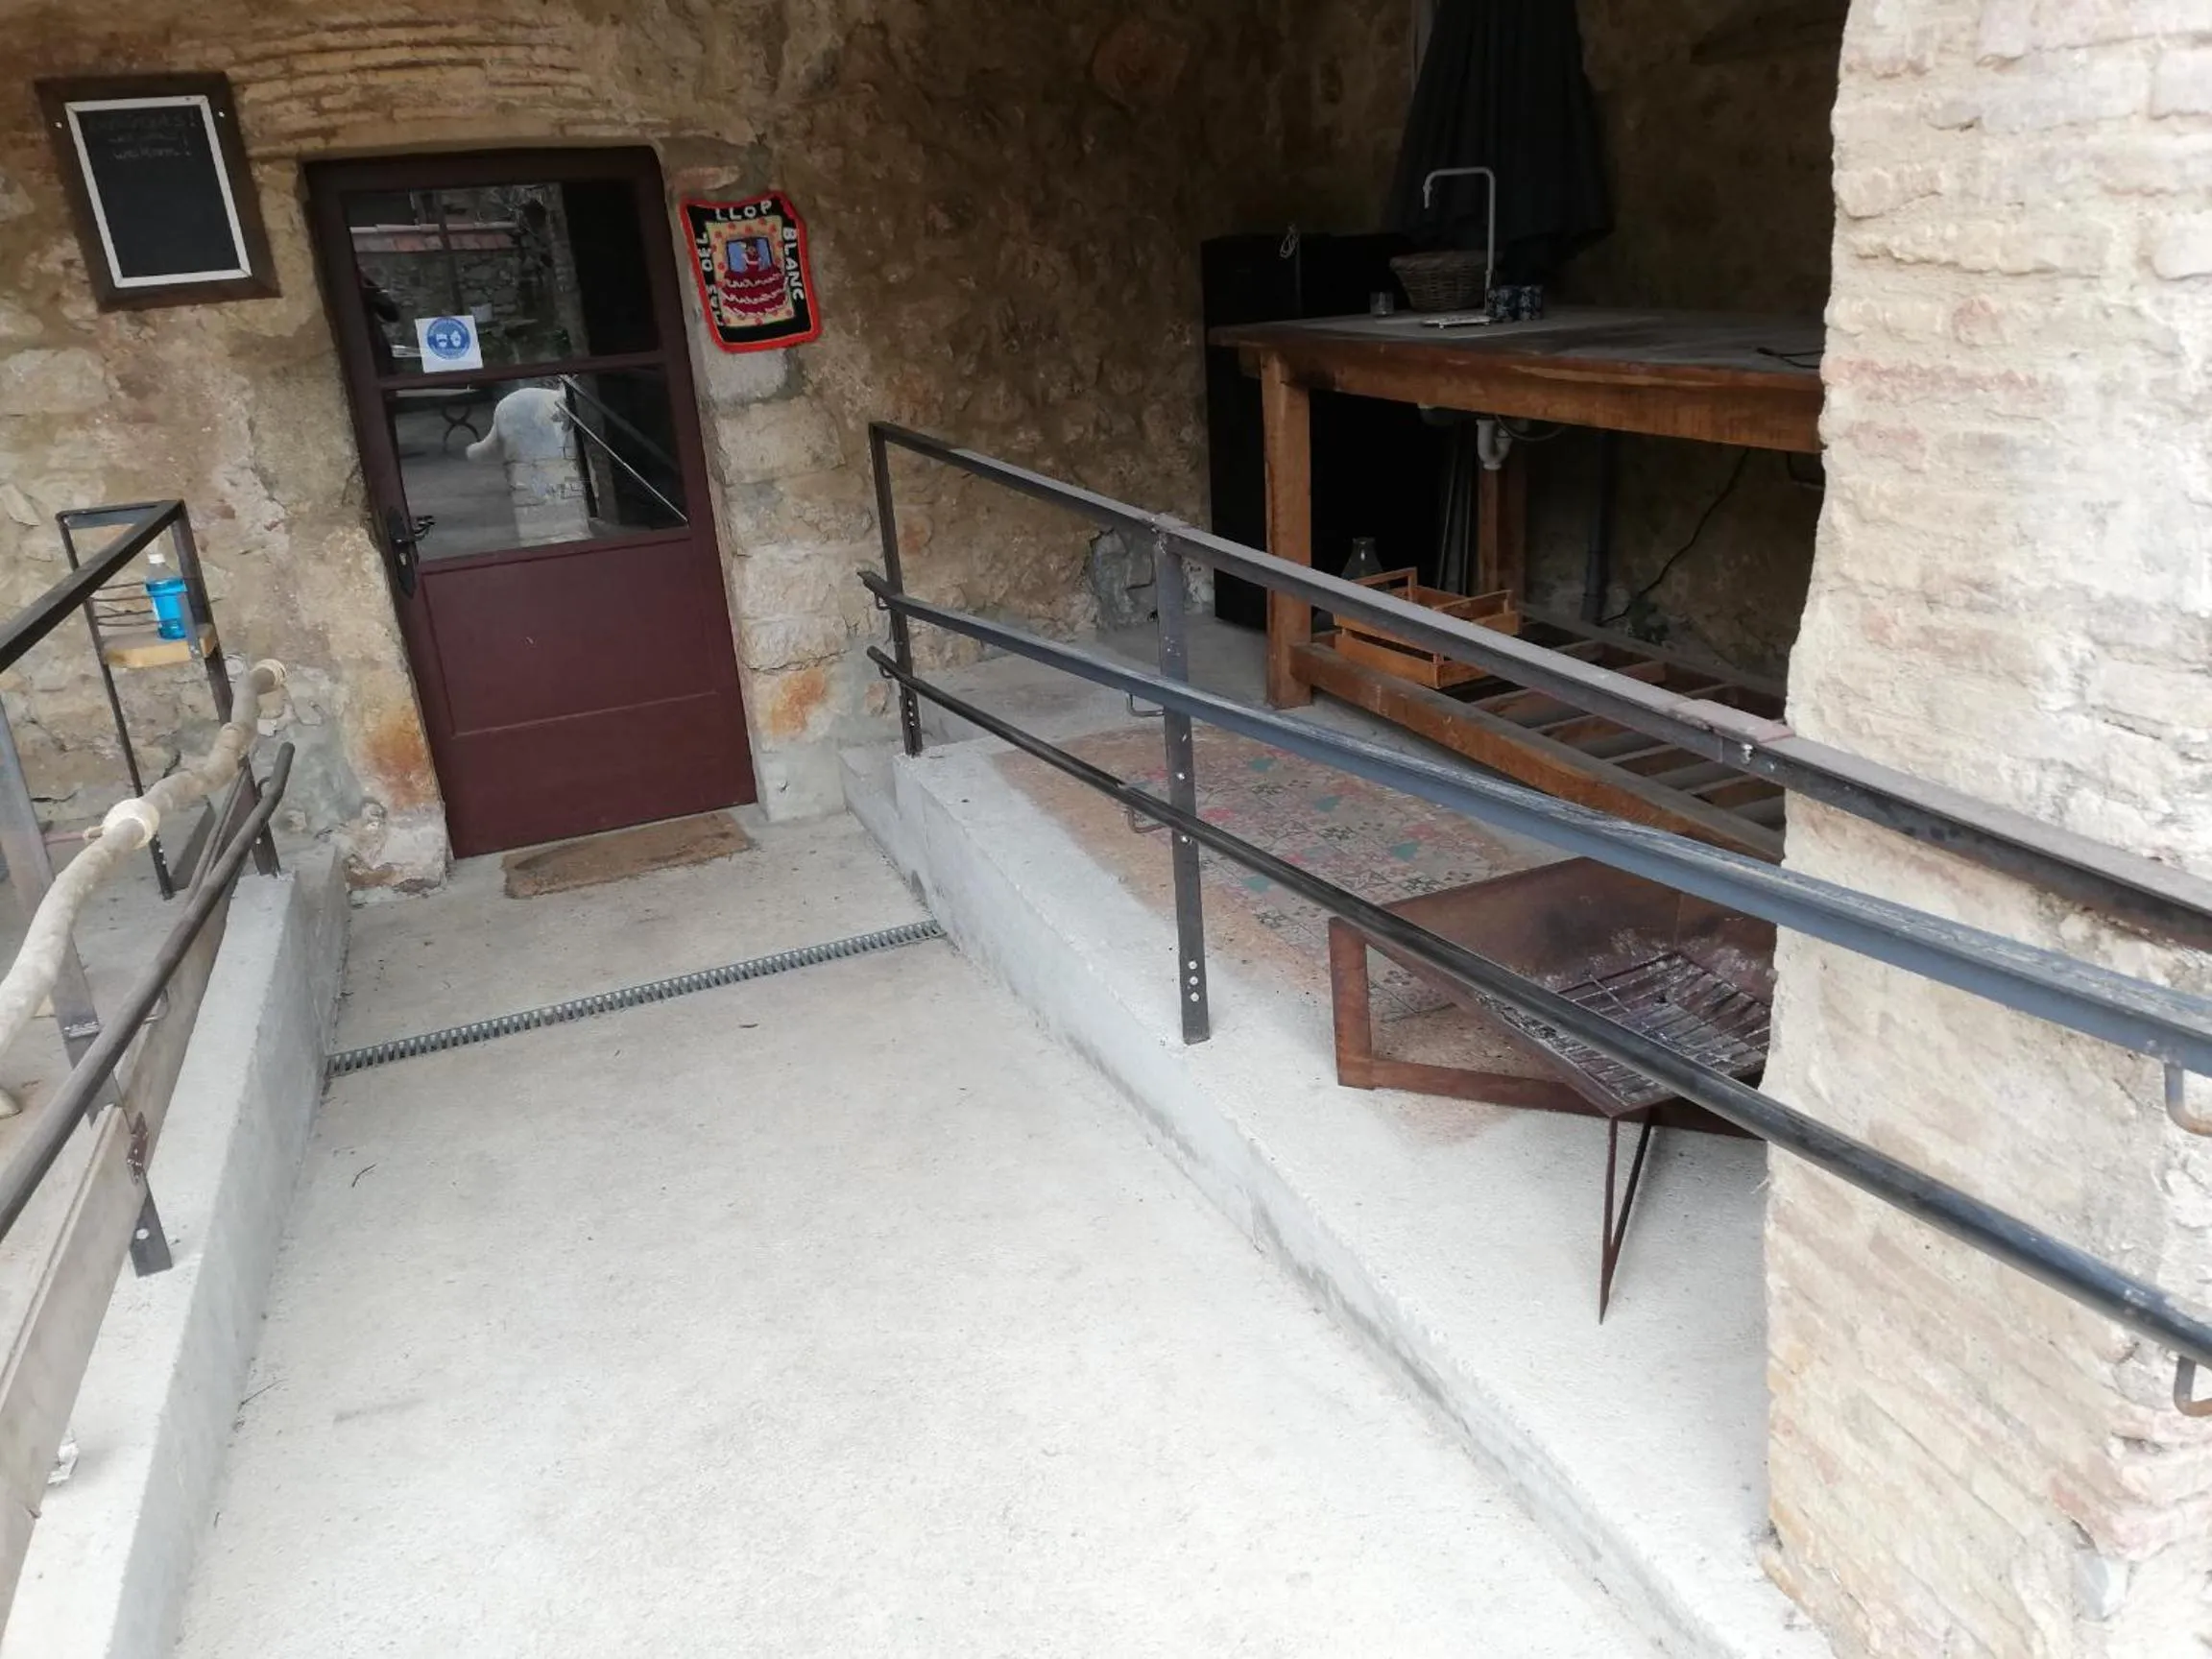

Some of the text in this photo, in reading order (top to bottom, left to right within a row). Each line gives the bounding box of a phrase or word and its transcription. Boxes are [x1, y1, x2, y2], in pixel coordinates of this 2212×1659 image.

[715, 200, 772, 221] LLOP
[696, 233, 712, 271] DEL
[783, 227, 805, 300] BLANC
